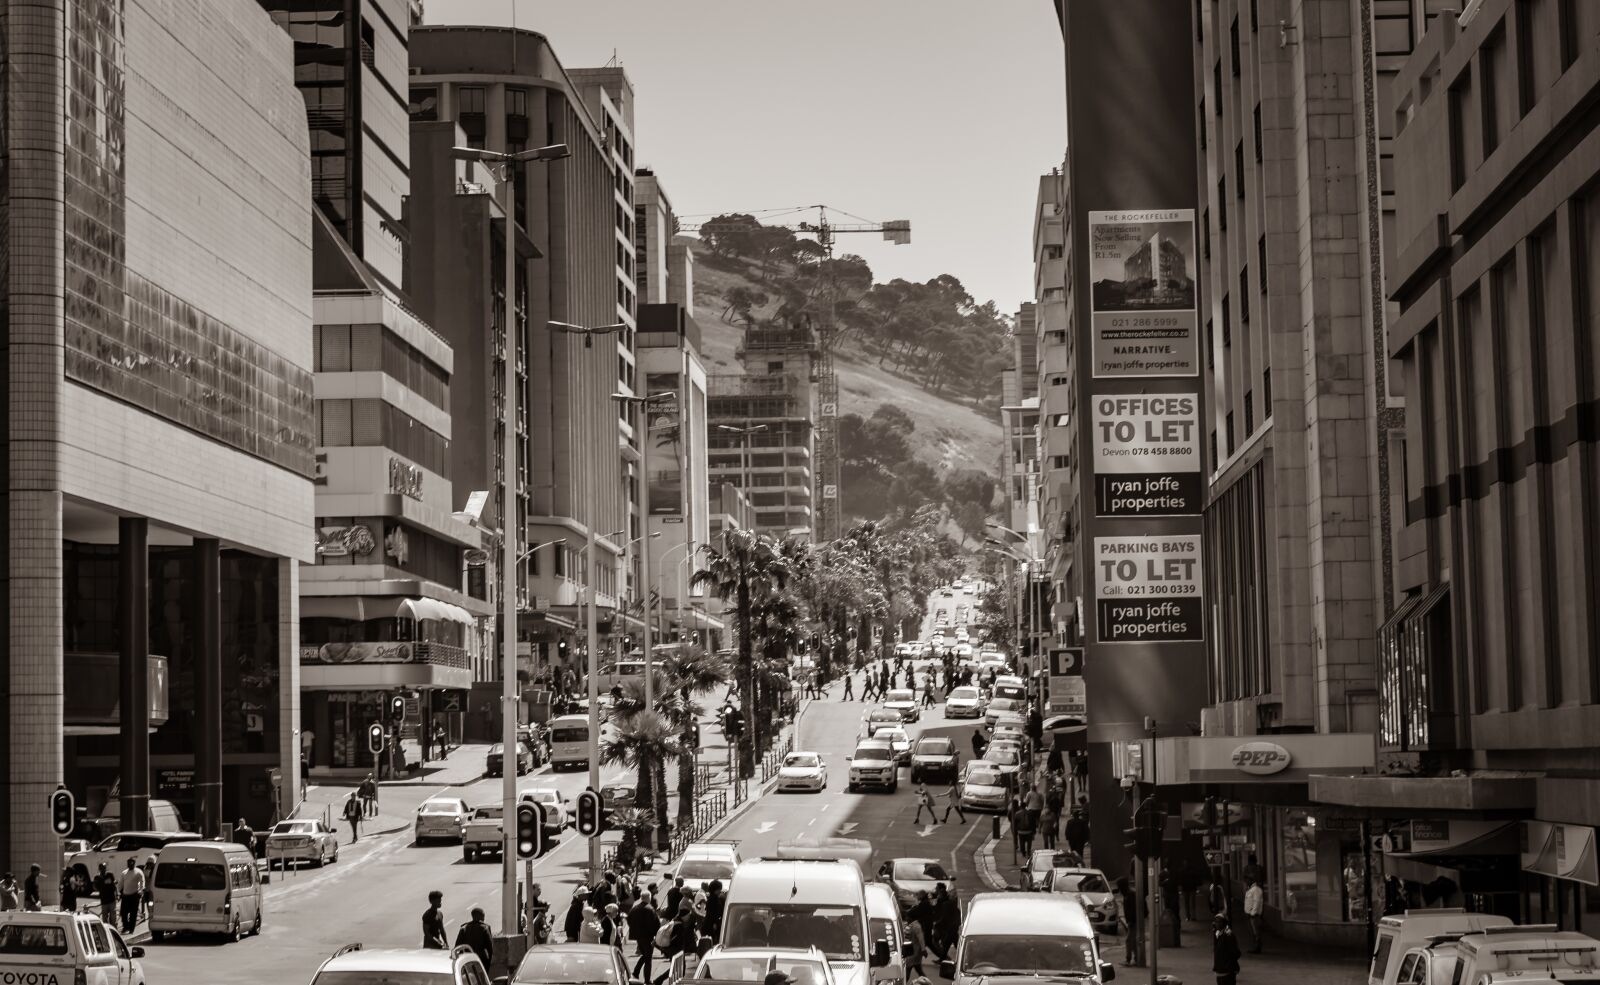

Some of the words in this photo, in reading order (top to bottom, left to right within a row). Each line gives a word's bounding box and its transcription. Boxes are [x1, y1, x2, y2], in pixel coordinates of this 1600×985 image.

[1121, 212, 1179, 221] ROCKEFELLER
[1094, 226, 1141, 236] Apartments
[1116, 234, 1142, 242] Selling
[1112, 319, 1129, 327] 021
[1133, 318, 1151, 326] 286
[1154, 318, 1178, 326] 5999
[1104, 361, 1122, 370] ryan
[1123, 360, 1144, 370] joffe
[1145, 360, 1190, 370] properties
[1099, 398, 1194, 416] OFFICES
[1099, 421, 1135, 443] TO
[1145, 420, 1194, 442] LET
[1102, 448, 1130, 456] Devon
[1132, 448, 1149, 456] 078
[1151, 447, 1168, 455] 458
[1169, 447, 1192, 455] 8800
[1111, 481, 1142, 495] ryan
[1144, 477, 1180, 495] joffe
[1112, 495, 1186, 512] properties
[1101, 543, 1159, 554] PARKING
[1162, 542, 1195, 552] BAYS
[1100, 559, 1137, 581] TO
[1147, 558, 1196, 581] LET
[1102, 586, 1124, 595] Call:
[1127, 586, 1146, 595] 021
[1149, 585, 1168, 594] 300
[1170, 584, 1196, 594] 0339
[1113, 607, 1143, 621] ryan
[1146, 602, 1181, 620] joffe
[1113, 620, 1187, 638] properties
[1058, 652, 1075, 674] P
[1236, 750, 1279, 766] PEP
